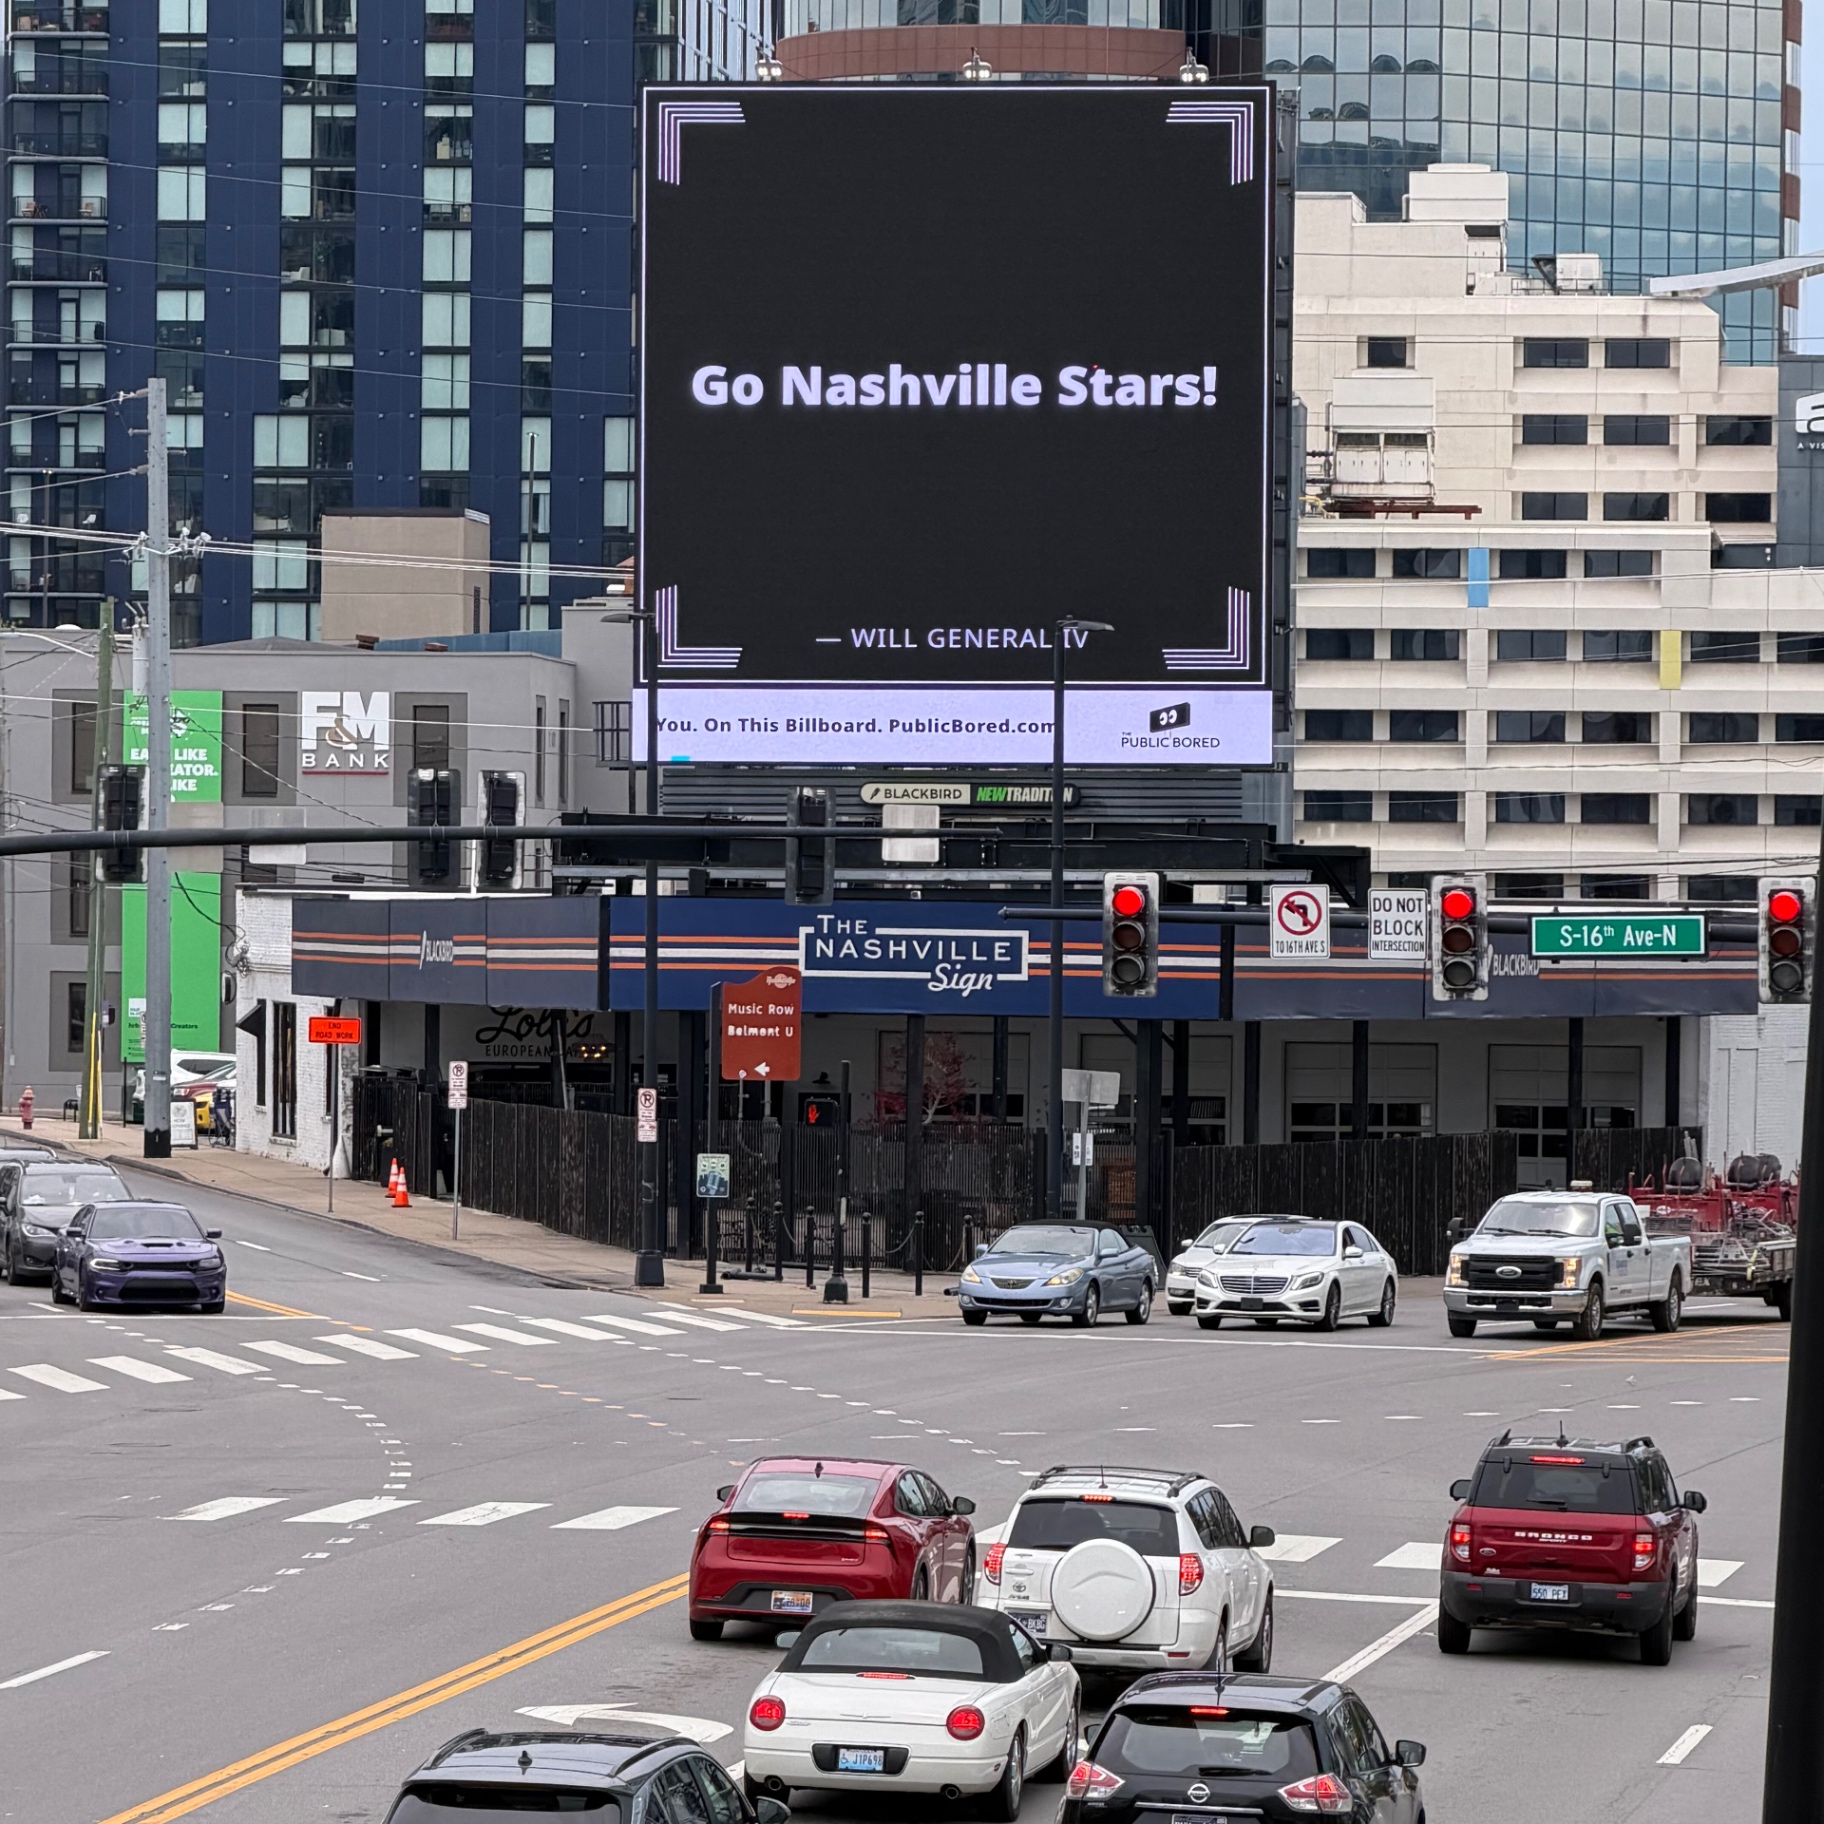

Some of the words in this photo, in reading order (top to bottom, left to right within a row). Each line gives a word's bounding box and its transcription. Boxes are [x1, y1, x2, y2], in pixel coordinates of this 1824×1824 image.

[692, 365, 764, 406] Go
[781, 363, 1042, 406] Nashville
[1057, 364, 1217, 406] Stars!
[851, 628, 917, 648] WILL
[927, 628, 1053, 649] GENERAL
[1063, 628, 1088, 648] IV
[302, 691, 389, 750] F&M
[657, 717, 697, 732] You.
[704, 718, 731, 732] On
[738, 717, 779, 732] This
[786, 718, 882, 733] Billboard.
[889, 719, 1055, 734] PublicBored.com
[1121, 737, 1169, 748] PUBLIC
[1172, 737, 1220, 748] BORED
[174, 748, 207, 761] LIKE
[302, 753, 389, 768] BANK
[170, 779, 197, 791] IKE
[884, 788, 962, 800] BLACKBIRD
[1373, 898, 1392, 912] DO
[1397, 898, 1424, 913] NOT
[1373, 920, 1424, 936] BLOCK
[1623, 925, 1677, 947] Ave-N
[426, 940, 453, 962] BLACKBIRD
[816, 939, 1011, 961] NASHVILLE
[1276, 940, 1285, 953] TO
[1286, 940, 1303, 953] 16TH
[1305, 940, 1319, 953] AVE
[1320, 940, 1325, 953] S
[1372, 940, 1425, 952] INTERSECTION
[1493, 954, 1540, 976] BLACKBIRD
[928, 963, 993, 997] Sign
[728, 1003, 763, 1014] Music
[768, 1003, 794, 1015] Row
[315, 1031, 332, 1039] ROAD
[728, 1025, 780, 1037] Belmont
[785, 1026, 794, 1037] U
[485, 1044, 551, 1057] EUROPEAN
